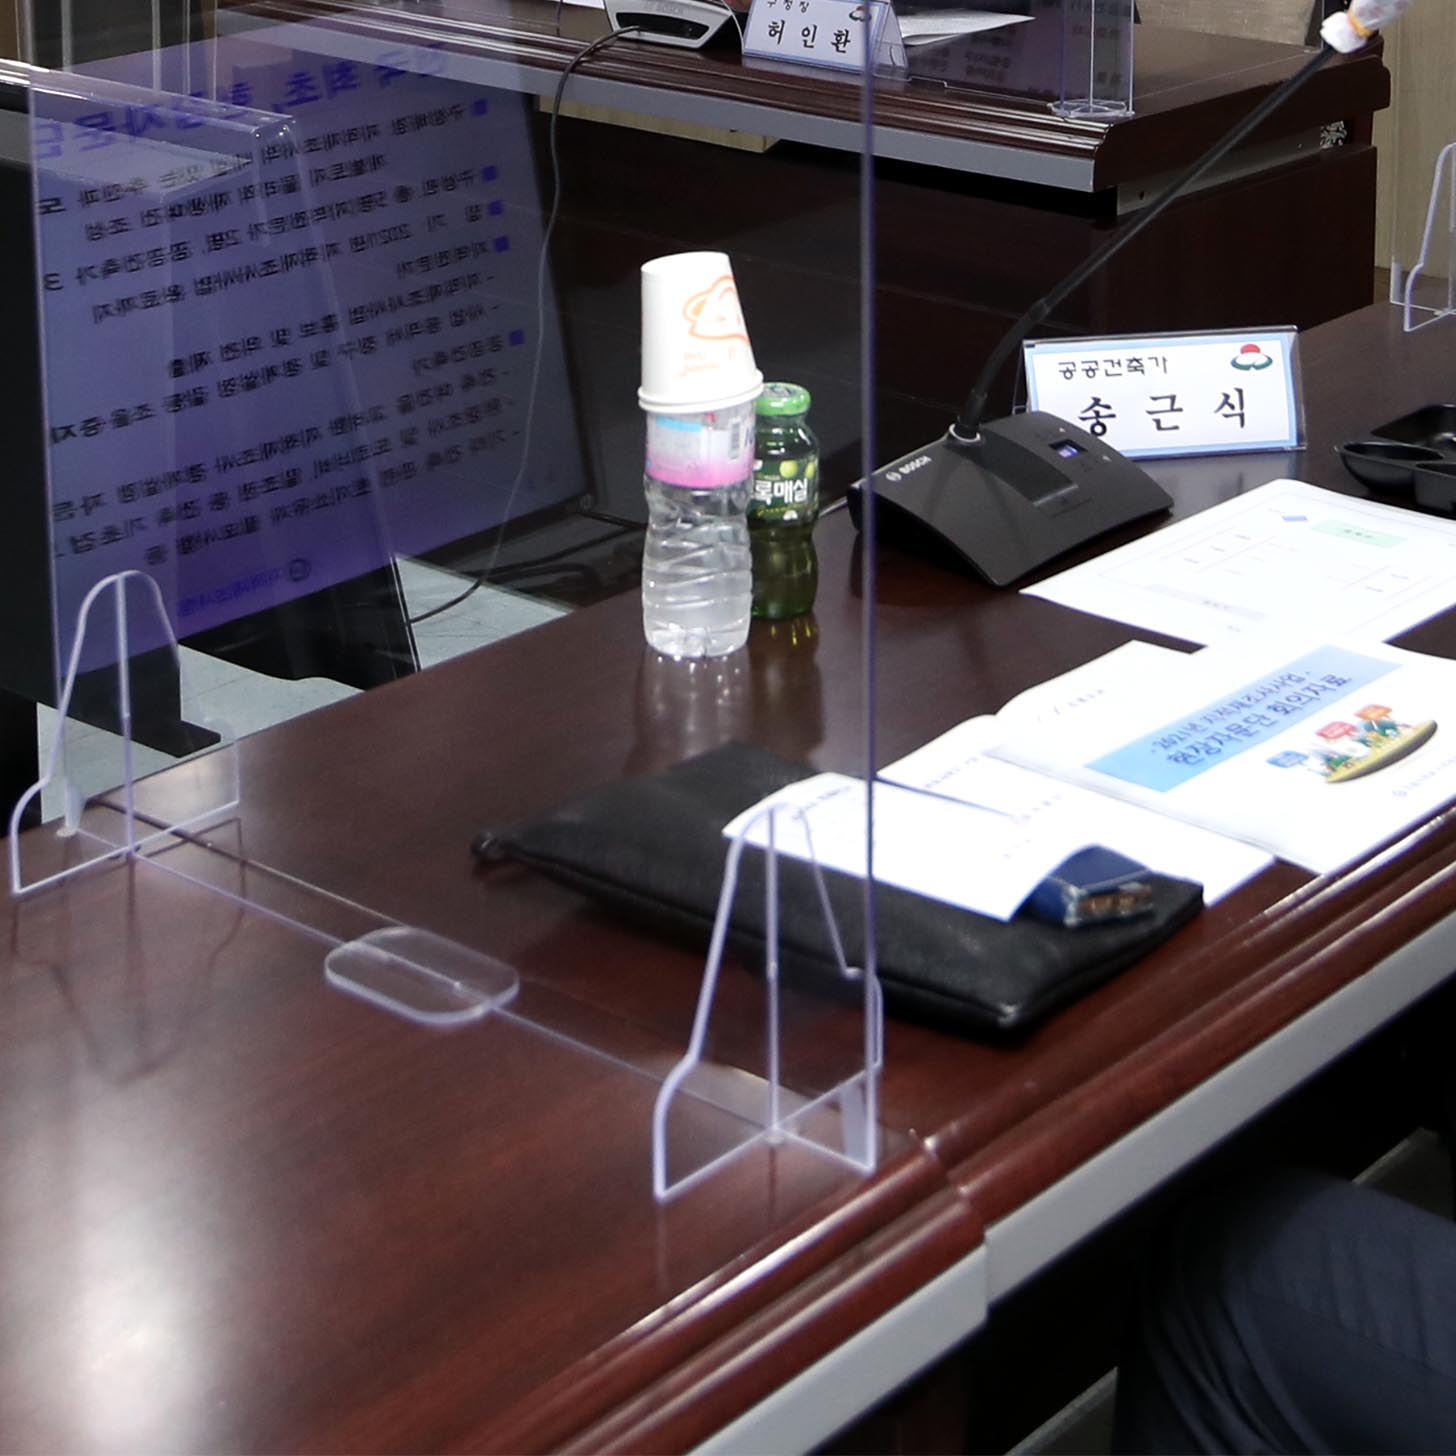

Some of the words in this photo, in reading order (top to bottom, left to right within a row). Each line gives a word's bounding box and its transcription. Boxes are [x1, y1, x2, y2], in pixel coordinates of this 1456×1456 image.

[1057, 355, 1169, 380] 공공건축가
[751, 478, 809, 505] 록매실
[1166, 713, 1279, 766] 현장자문단
[1266, 672, 1353, 716] 회의자료
